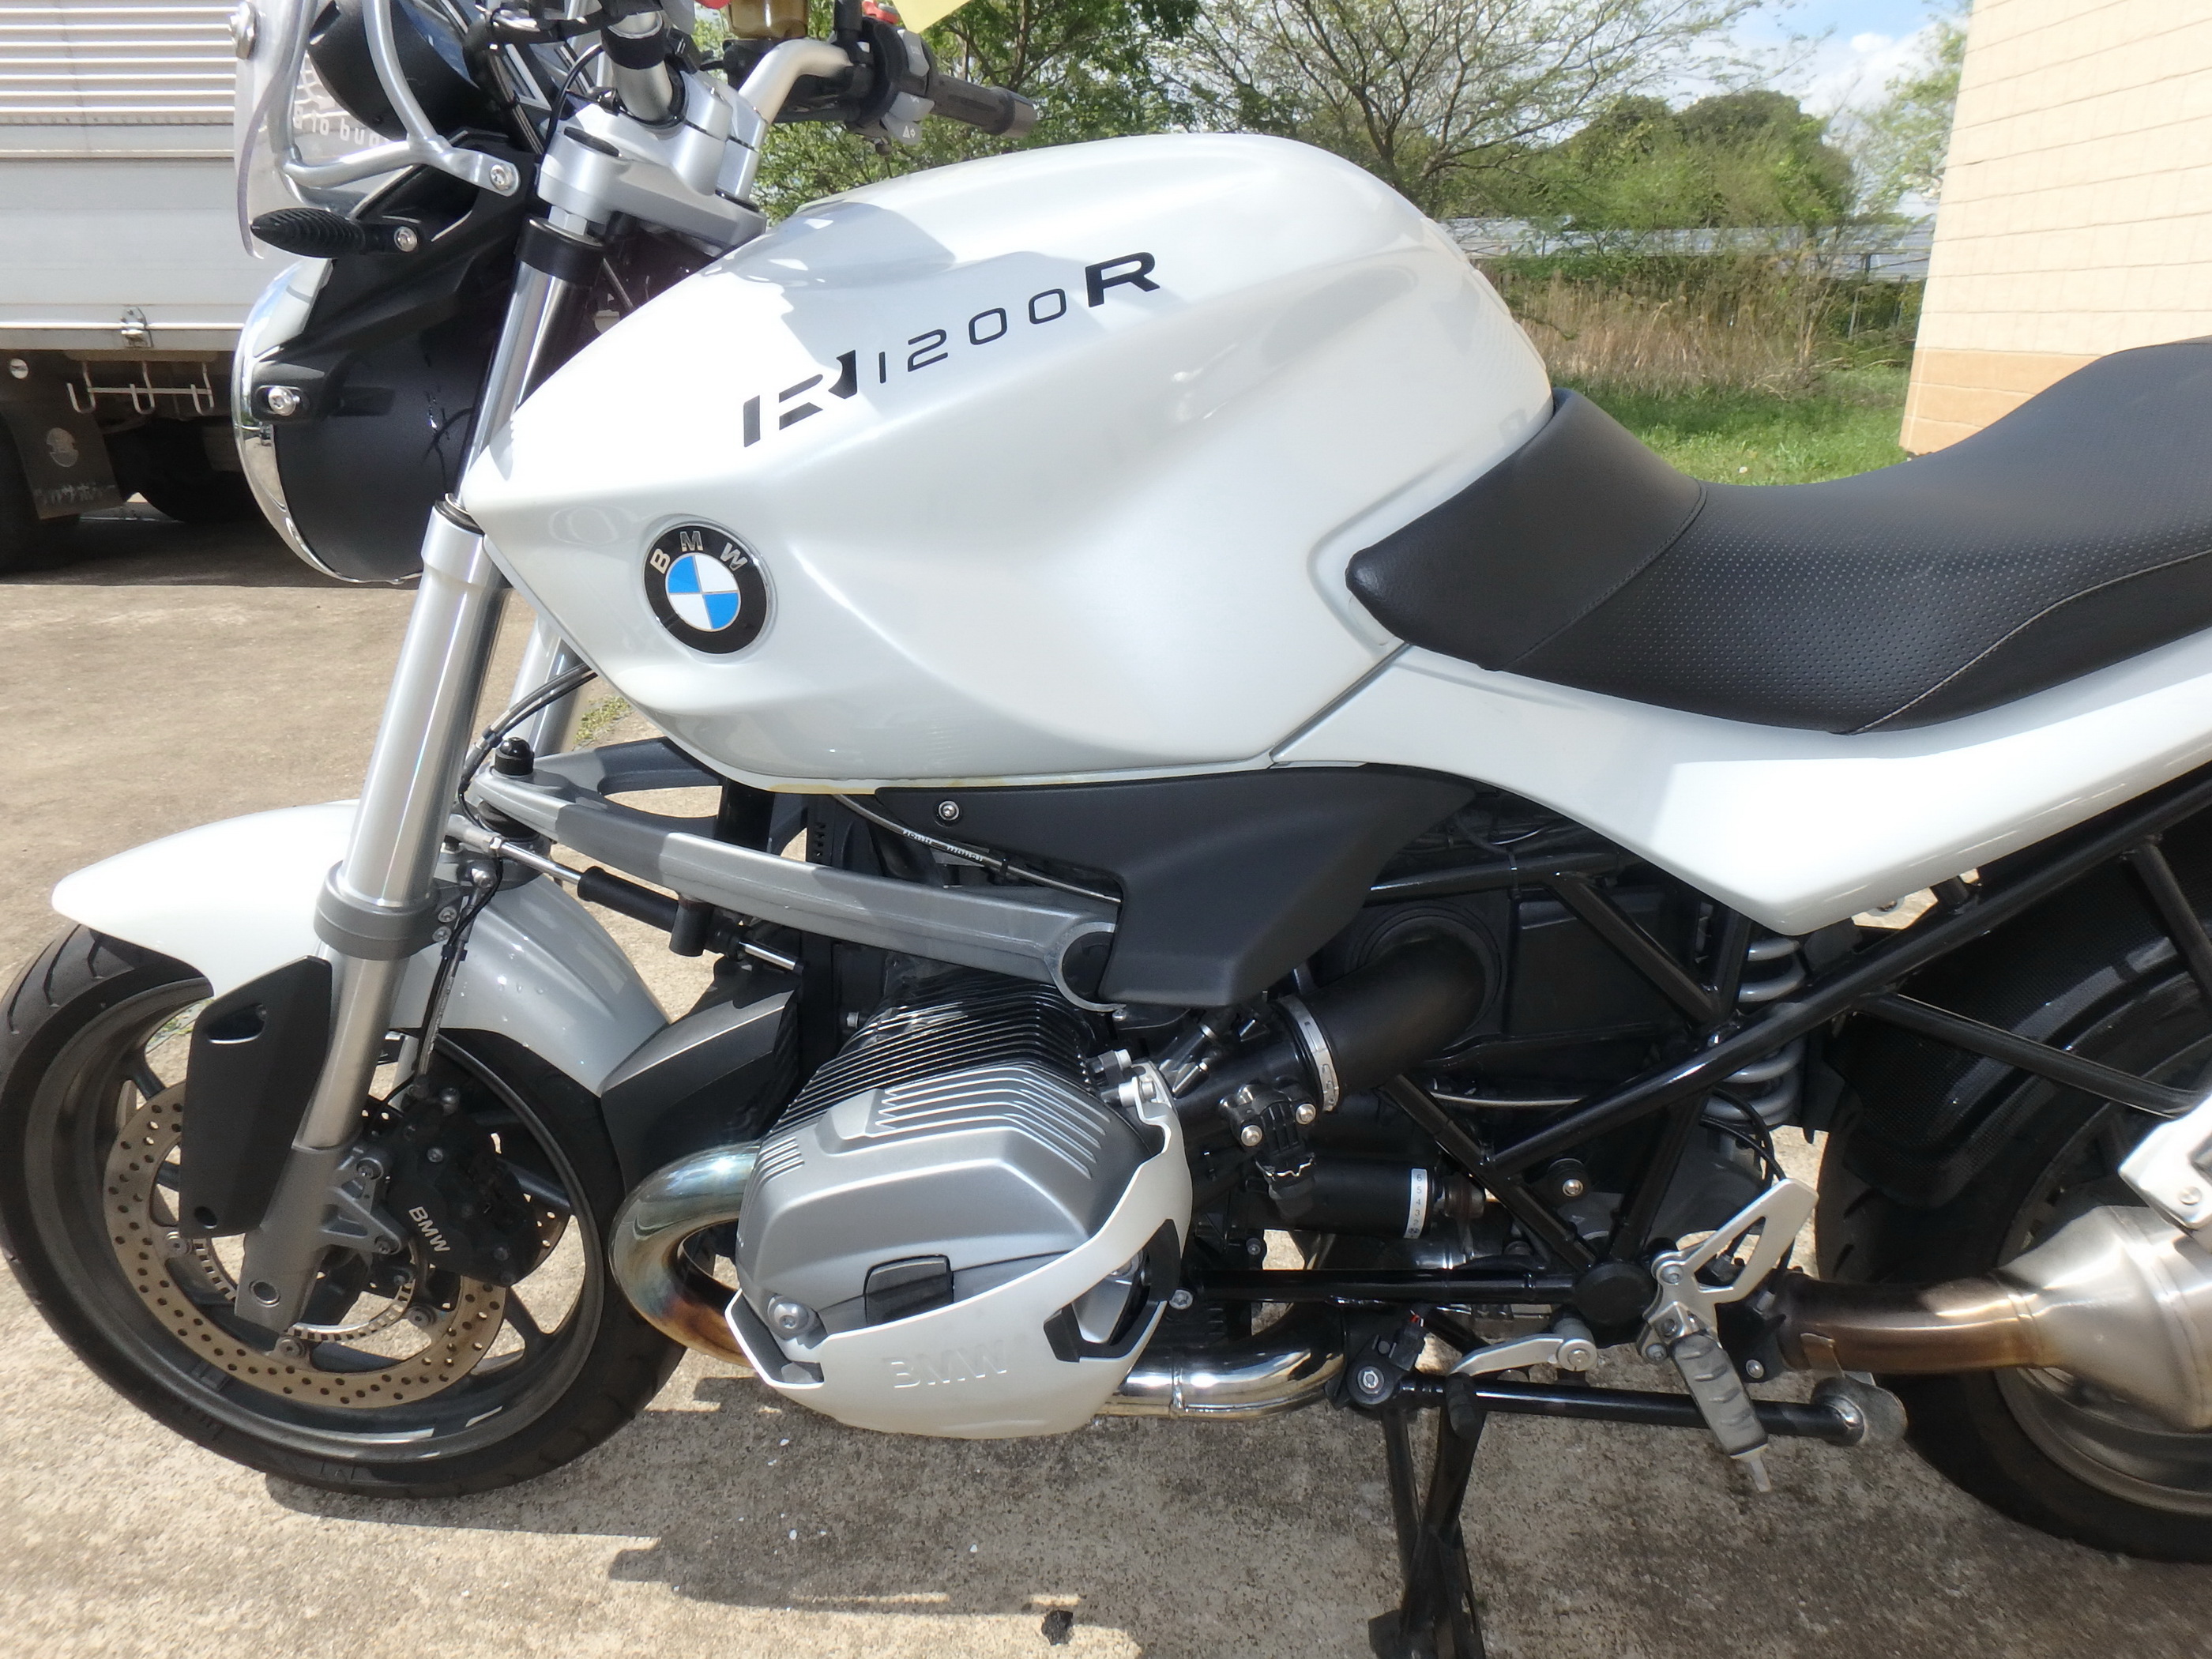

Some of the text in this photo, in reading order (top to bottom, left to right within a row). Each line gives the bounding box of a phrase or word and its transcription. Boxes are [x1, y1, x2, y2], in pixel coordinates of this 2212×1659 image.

[649, 530, 748, 574] BMW
[1416, 1173, 1423, 1182] 6
[1416, 1186, 1422, 1194] 5
[408, 1206, 451, 1252] BMW
[882, 1341, 1007, 1388] BMW
